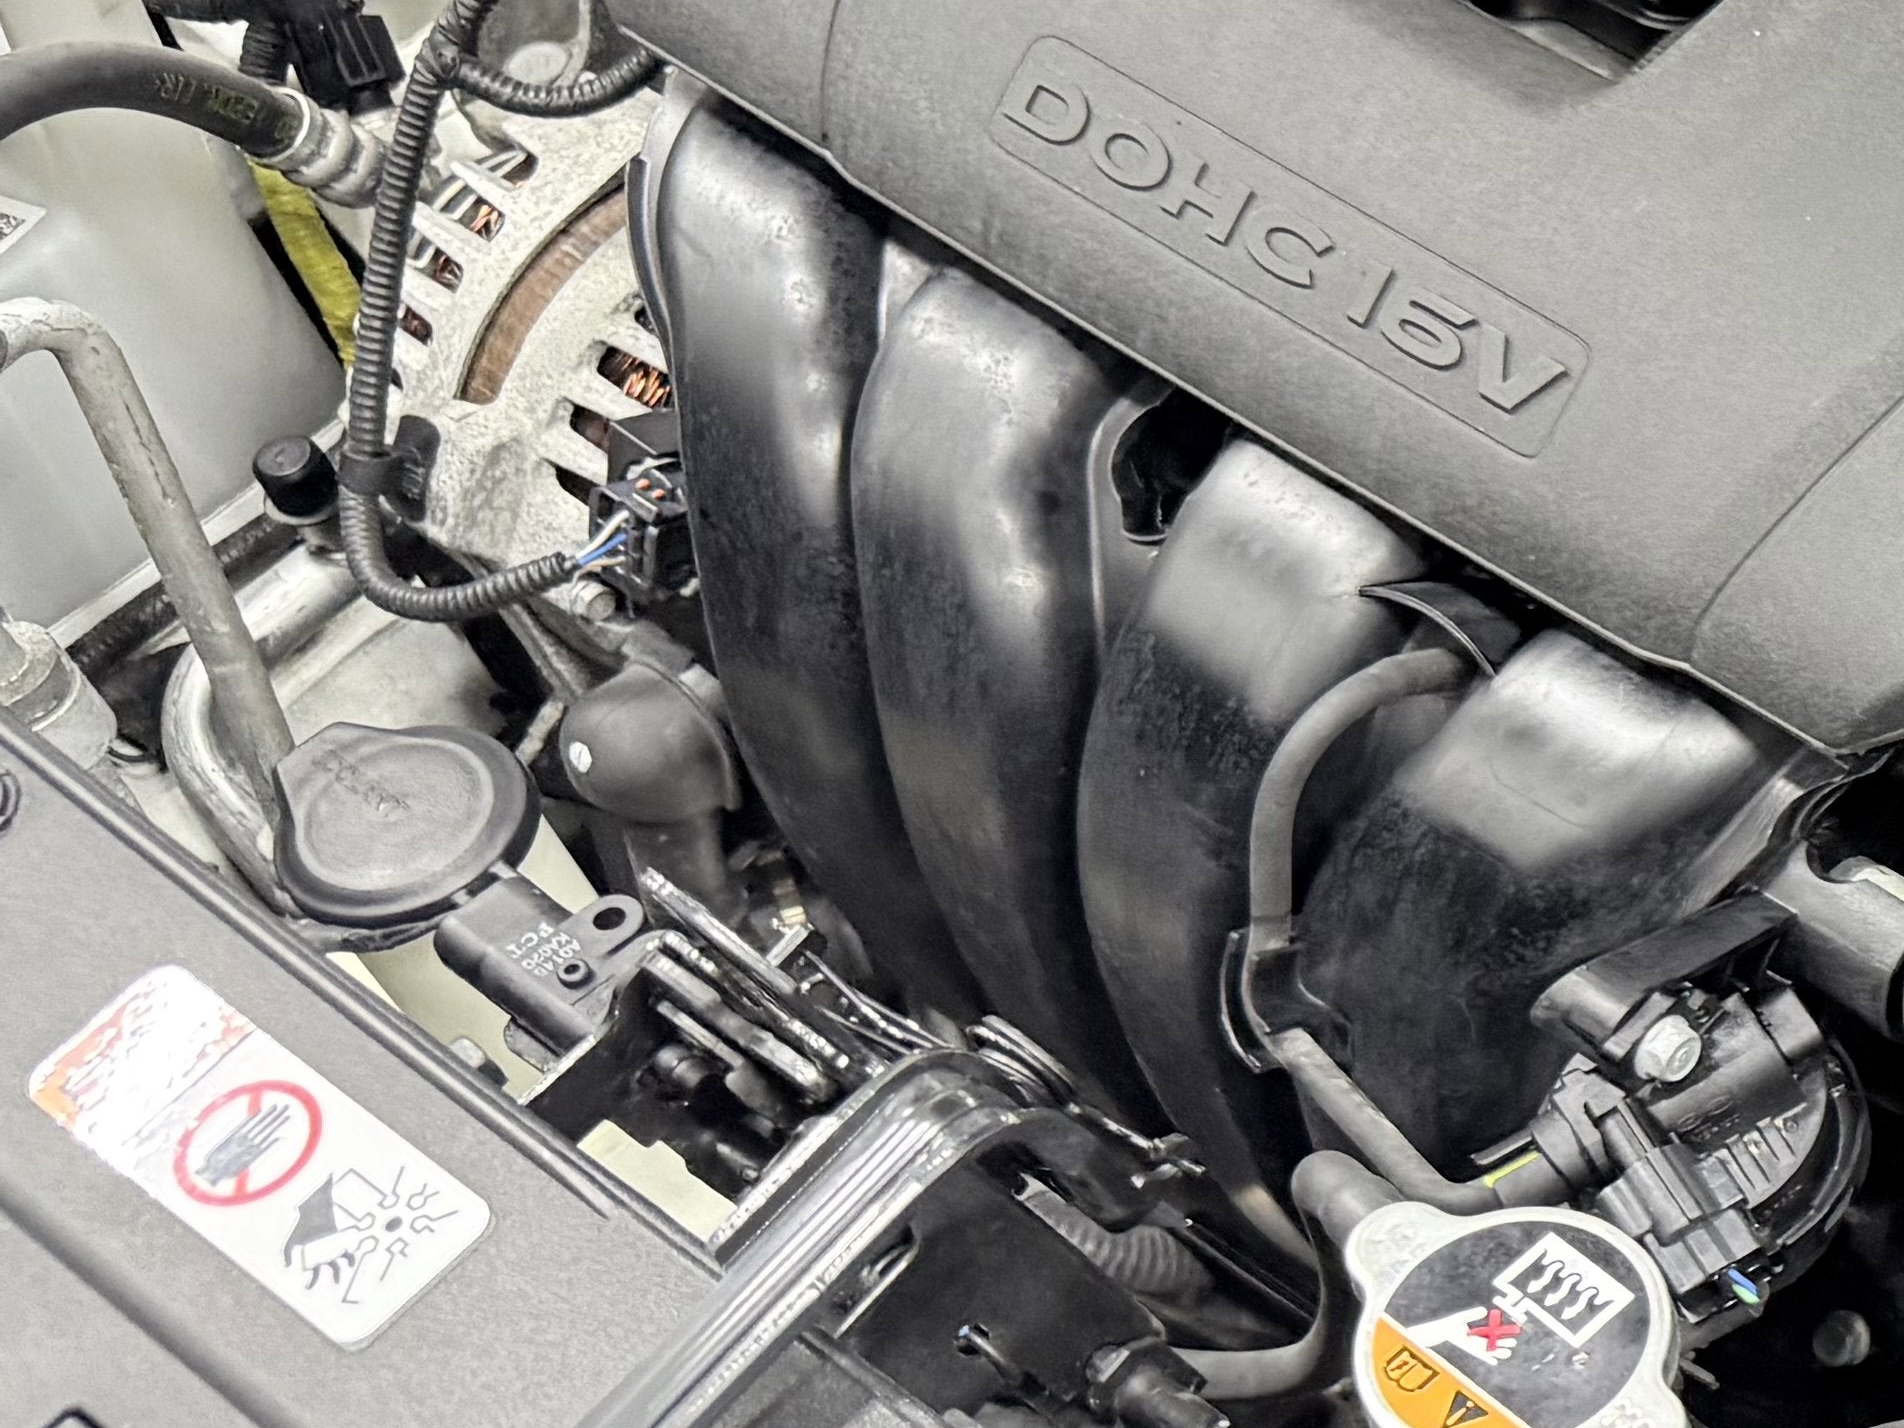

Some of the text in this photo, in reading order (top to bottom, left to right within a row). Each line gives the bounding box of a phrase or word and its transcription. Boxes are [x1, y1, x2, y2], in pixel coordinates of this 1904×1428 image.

[997, 60, 1568, 429] DOHC 16V
[504, 919, 555, 960] PCT
